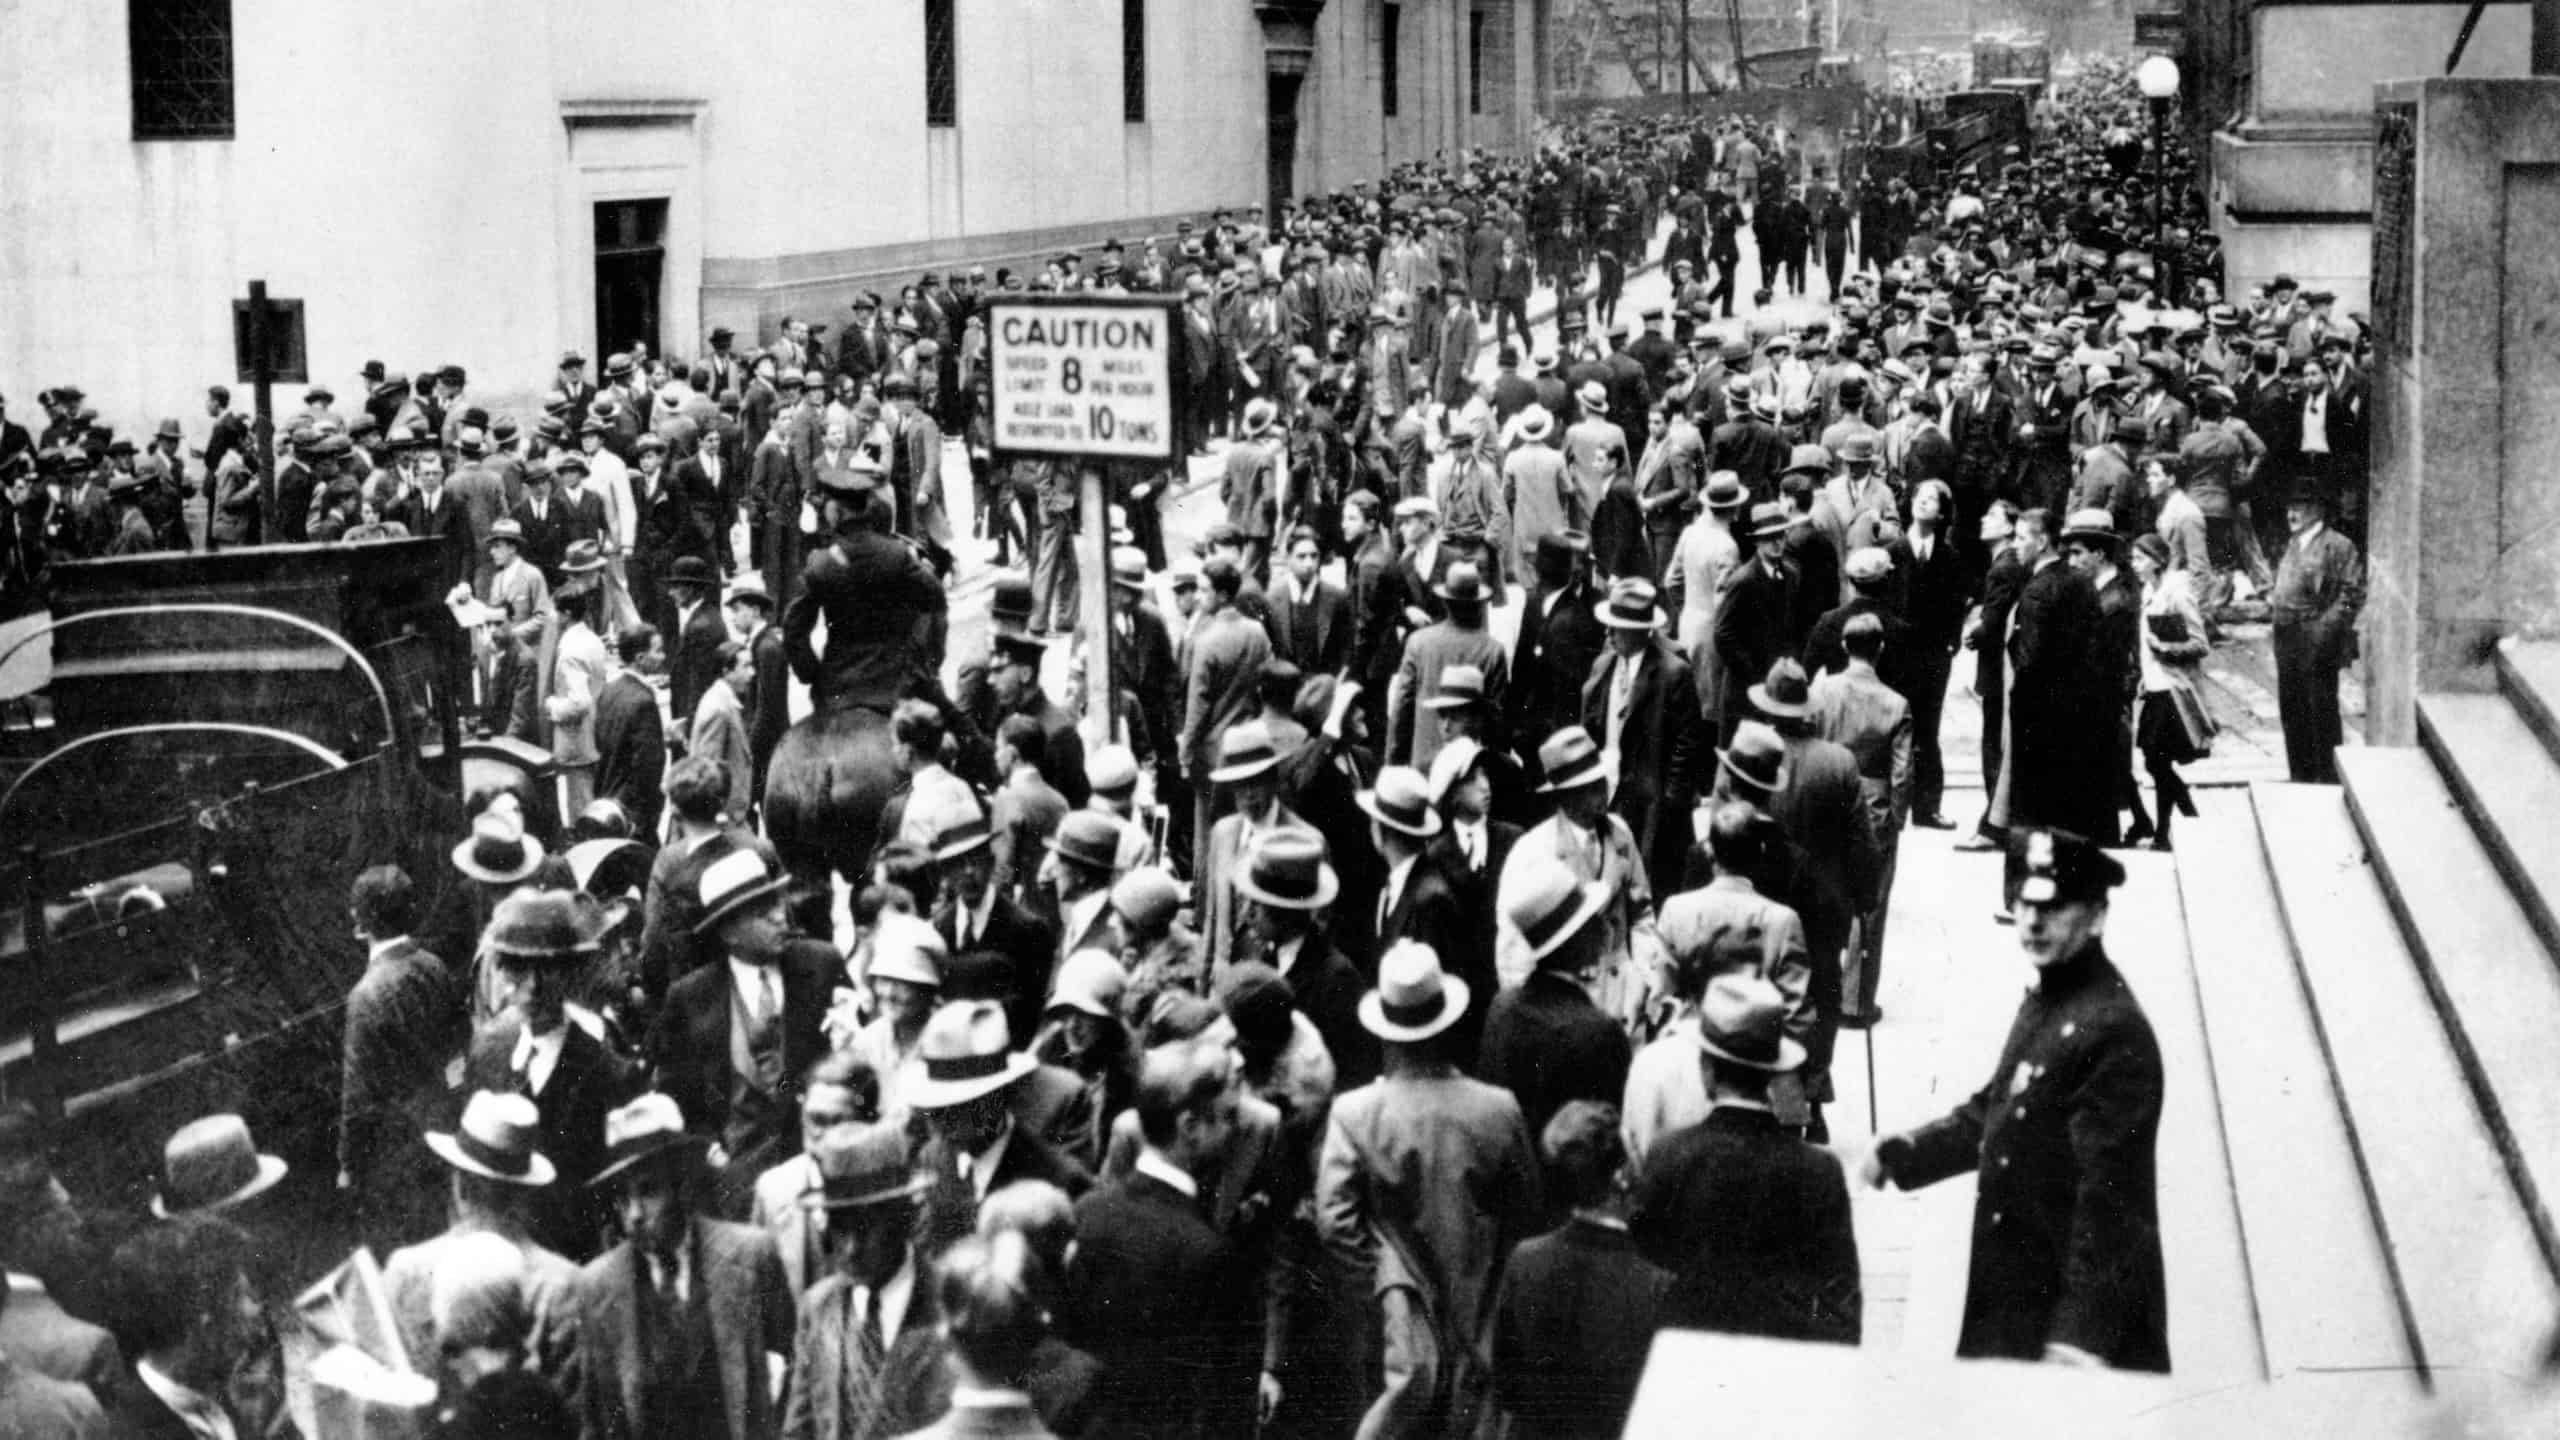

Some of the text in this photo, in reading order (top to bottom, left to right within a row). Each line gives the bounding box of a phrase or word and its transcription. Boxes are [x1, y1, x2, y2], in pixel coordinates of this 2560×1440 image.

[1003, 317, 1154, 349] CAUTION
[1062, 356, 1082, 394] 8
[1089, 404, 1115, 440] 10
[1119, 420, 1158, 444] TONS
